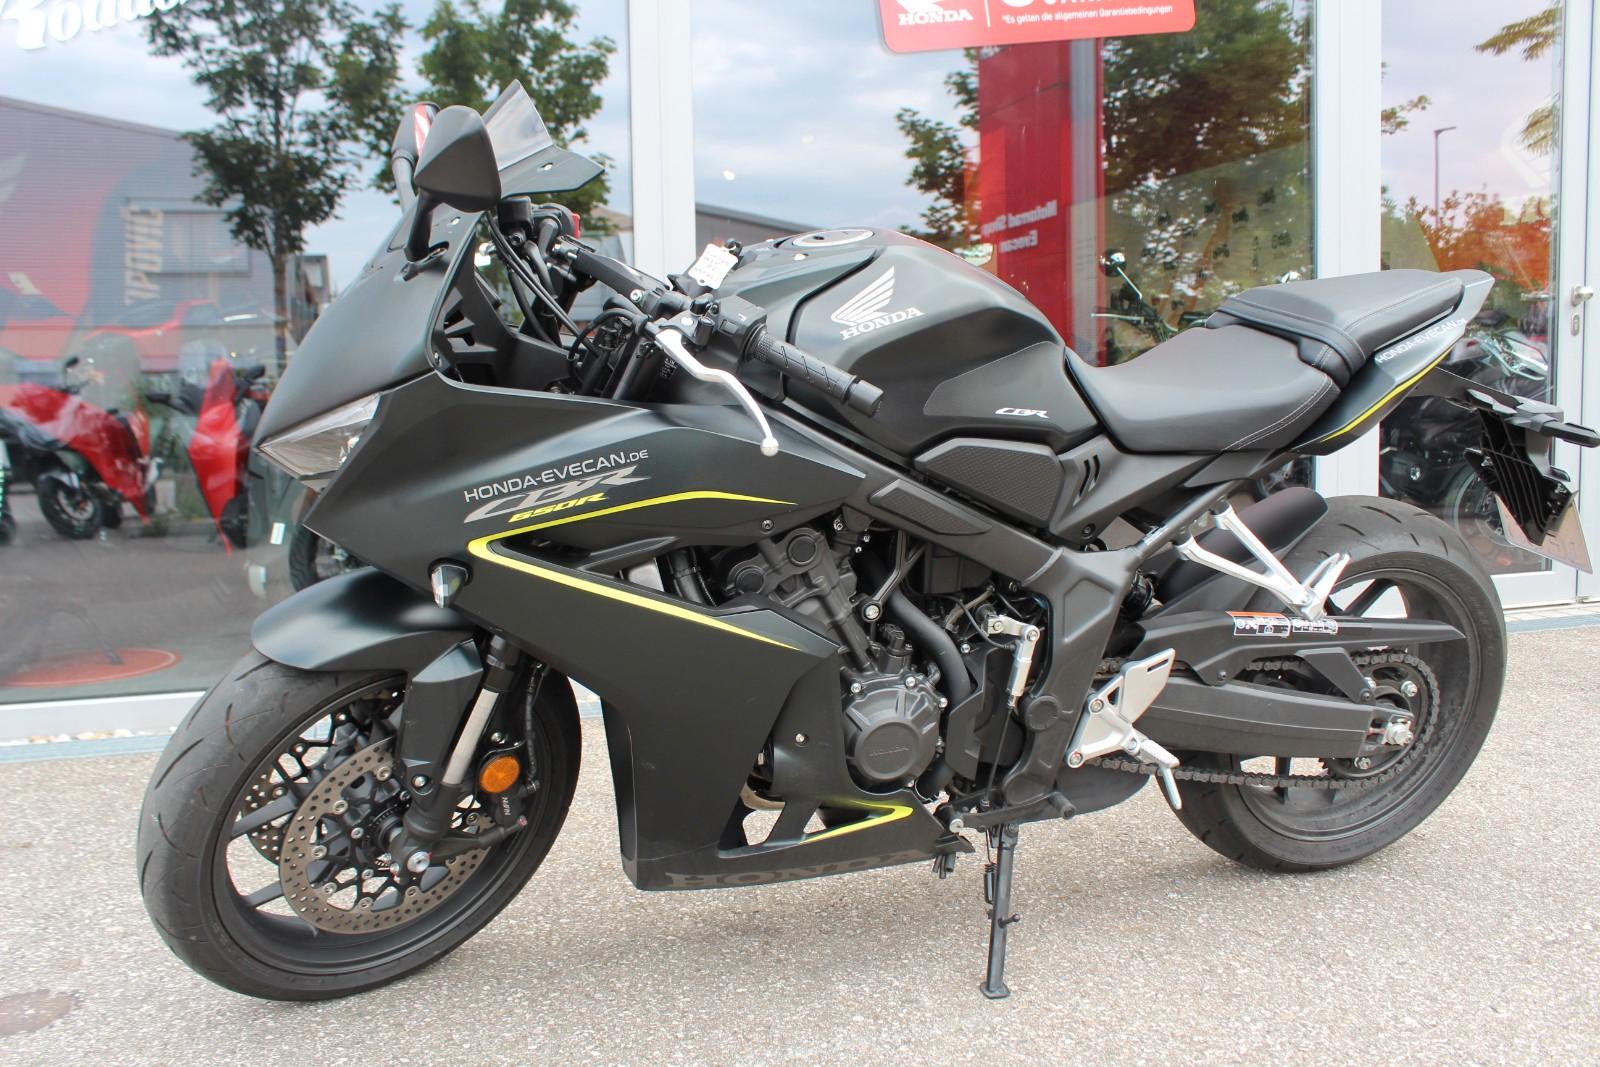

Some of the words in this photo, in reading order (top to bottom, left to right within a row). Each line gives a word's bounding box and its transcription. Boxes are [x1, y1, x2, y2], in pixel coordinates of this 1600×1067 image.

[897, 12, 974, 26] HONDA
[1041, 12, 1053, 22] die
[1054, 10, 1098, 22] allgemeinen
[1099, 5, 1173, 17] Garantiebedingungen
[839, 306, 925, 341] HONDA
[995, 407, 1050, 419] CBR
[463, 449, 650, 503] HONDA-EVECAN.DE
[463, 465, 651, 523] CBR
[507, 491, 609, 523] 650R
